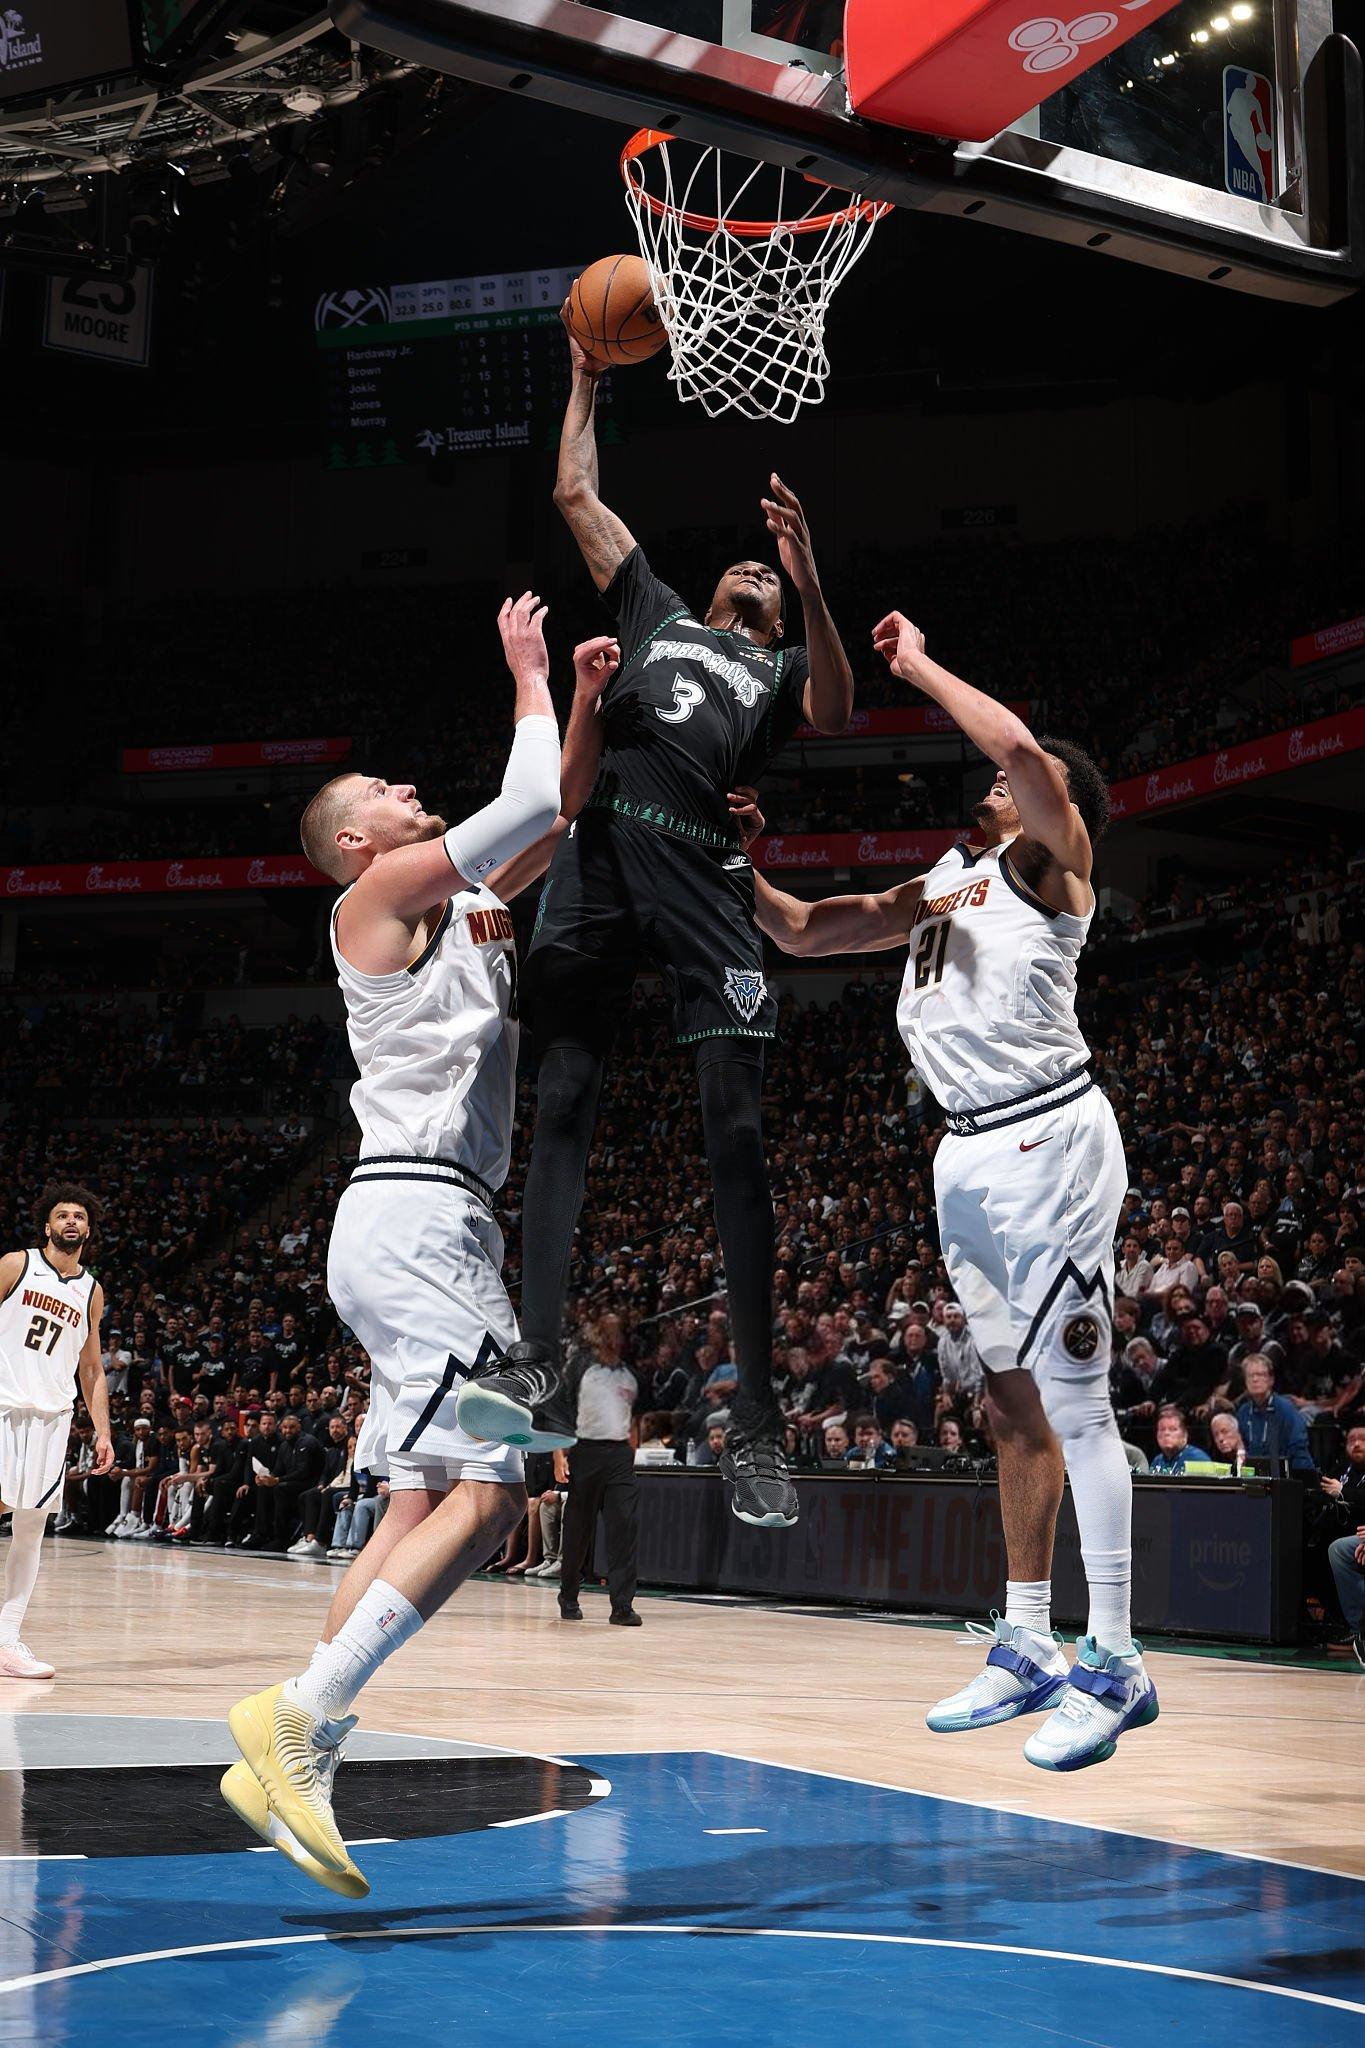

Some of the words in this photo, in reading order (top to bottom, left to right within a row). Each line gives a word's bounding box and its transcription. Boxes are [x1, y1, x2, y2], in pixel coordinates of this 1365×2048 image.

[8, 33, 42, 60] Island
[1232, 167, 1256, 193] NBA
[507, 279, 524, 288] AST
[537, 276, 550, 285] TO
[422, 301, 444, 313] 25.0
[512, 294, 523, 304] 11
[542, 291, 549, 301] 9
[65, 312, 130, 343] MOORE
[495, 317, 512, 326] AST
[346, 348, 398, 361] Hardaway
[347, 367, 382, 378] Brown
[349, 383, 377, 394] Jokic
[479, 370, 491, 381] 15
[350, 401, 382, 411] Jones
[350, 417, 387, 427] Murray
[446, 426, 493, 443] Treasure
[495, 420, 531, 439] Island
[963, 509, 996, 525] 226
[642, 639, 770, 709] TIMBERWOLVES
[655, 672, 706, 724] 3
[912, 879, 991, 927] NUGGETS
[915, 919, 953, 990] 21
[22, 1289, 81, 1329] NUGGETS
[24, 1314, 64, 1356] 27
[840, 1493, 912, 1590] THE
[919, 1495, 1004, 1598] LOG
[1189, 1528, 1252, 1569] prime
